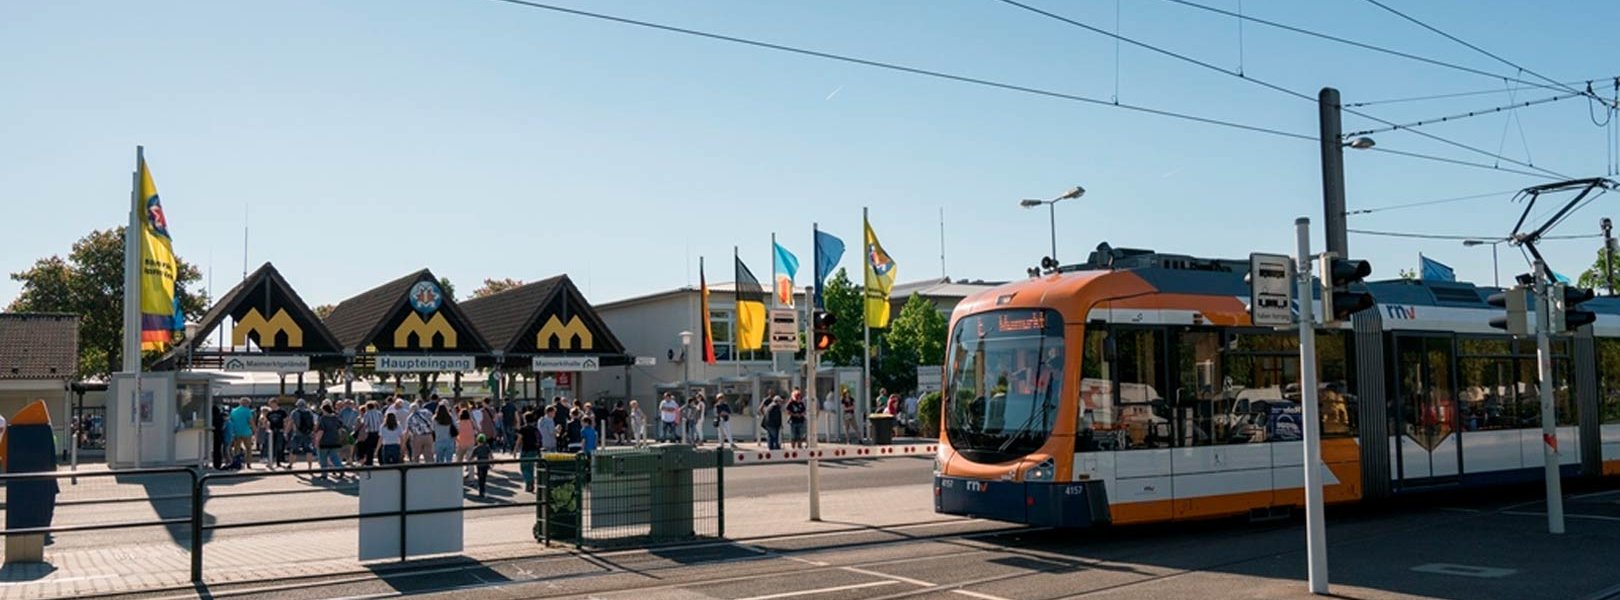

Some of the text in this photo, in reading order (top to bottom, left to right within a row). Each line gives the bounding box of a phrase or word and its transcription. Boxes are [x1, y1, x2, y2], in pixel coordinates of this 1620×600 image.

[1385, 304, 1415, 320] rnv
[246, 360, 307, 369] Maimarktgelände
[381, 358, 470, 369] Haupteingang
[966, 480, 988, 492] rnv
[1065, 485, 1083, 495] 4157
